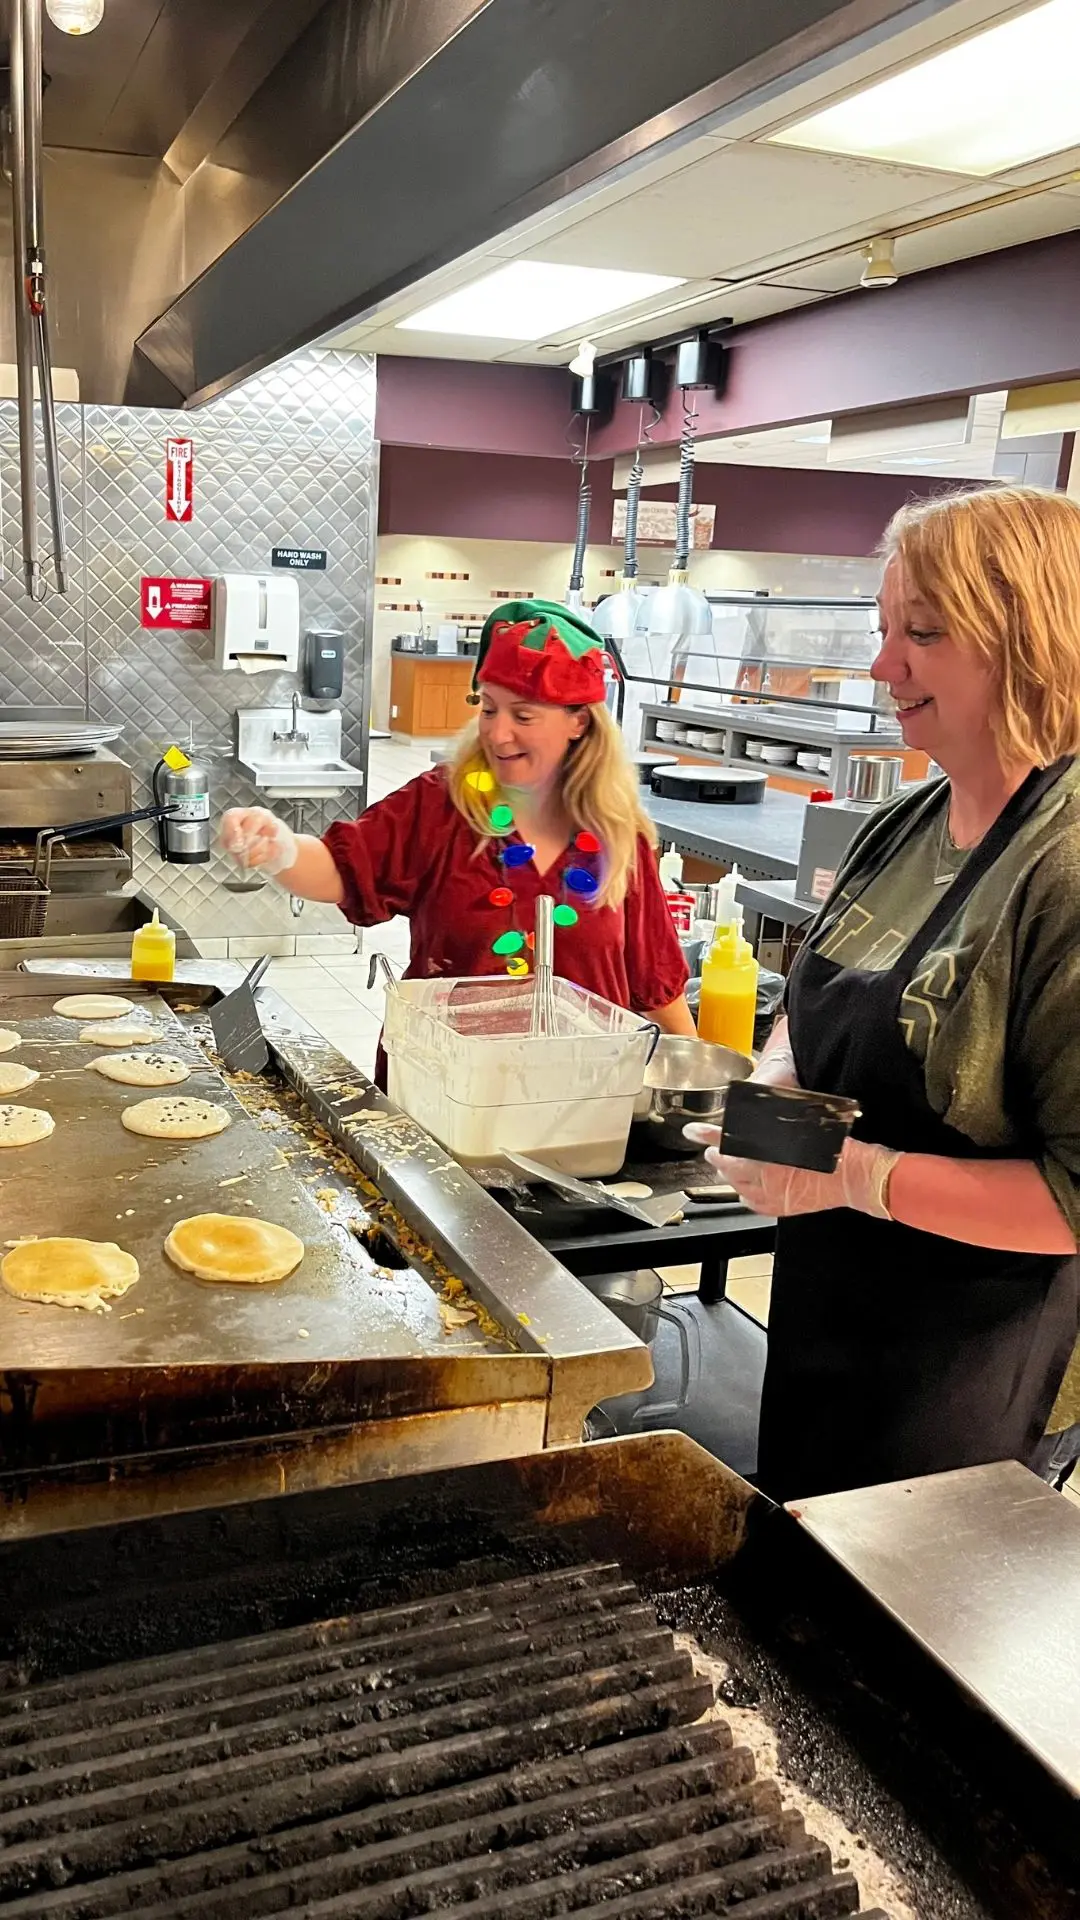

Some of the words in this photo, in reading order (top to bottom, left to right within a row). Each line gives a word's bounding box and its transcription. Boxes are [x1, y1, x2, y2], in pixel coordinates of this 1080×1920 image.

[171, 447, 188, 458] FIRE
[277, 550, 299, 559] HAND
[300, 551, 322, 560] WASH
[289, 558, 310, 567] ONLY
